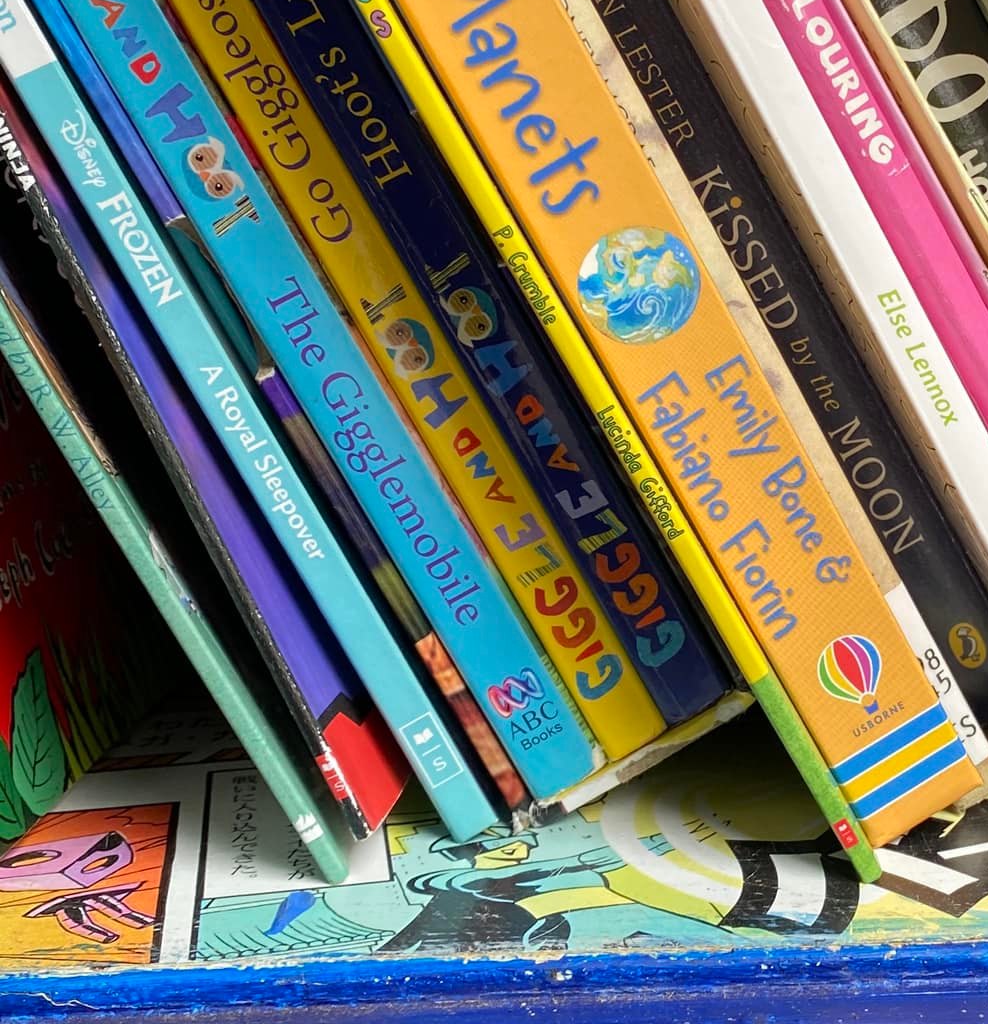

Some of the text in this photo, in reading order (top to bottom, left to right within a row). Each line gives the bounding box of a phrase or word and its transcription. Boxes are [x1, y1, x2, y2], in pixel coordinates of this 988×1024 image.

[315, 46, 413, 190] Hoot's
[96, 189, 184, 309] FROZEN
[307, 178, 353, 244] Go
[492, 224, 558, 327] P. Crumble
[614, 24, 695, 148] LESTER
[789, 336, 816, 367] by
[810, 374, 841, 413] the
[828, 416, 925, 556] MOON
[876, 288, 959, 427] Else Lennox
[7, 351, 34, 378] by
[29, 383, 52, 411] R.
[50, 412, 77, 449] W.
[71, 455, 115, 511] Alley
[199, 364, 326, 561] A Royal Sleepover
[267, 276, 481, 626] The Gigglemobile
[453, 427, 516, 504] AND
[515, 394, 581, 472] AND
[595, 405, 685, 541] Lucinda Gifford
[704, 353, 852, 584] Emily Bone &
[554, 479, 686, 668] GIGGLE
[637, 370, 798, 640] Fabiano Fiorin
[494, 513, 624, 701] GIGGLE
[511, 700, 559, 741] ABC
[520, 722, 564, 751] Books
[852, 700, 906, 737] USBORNE
